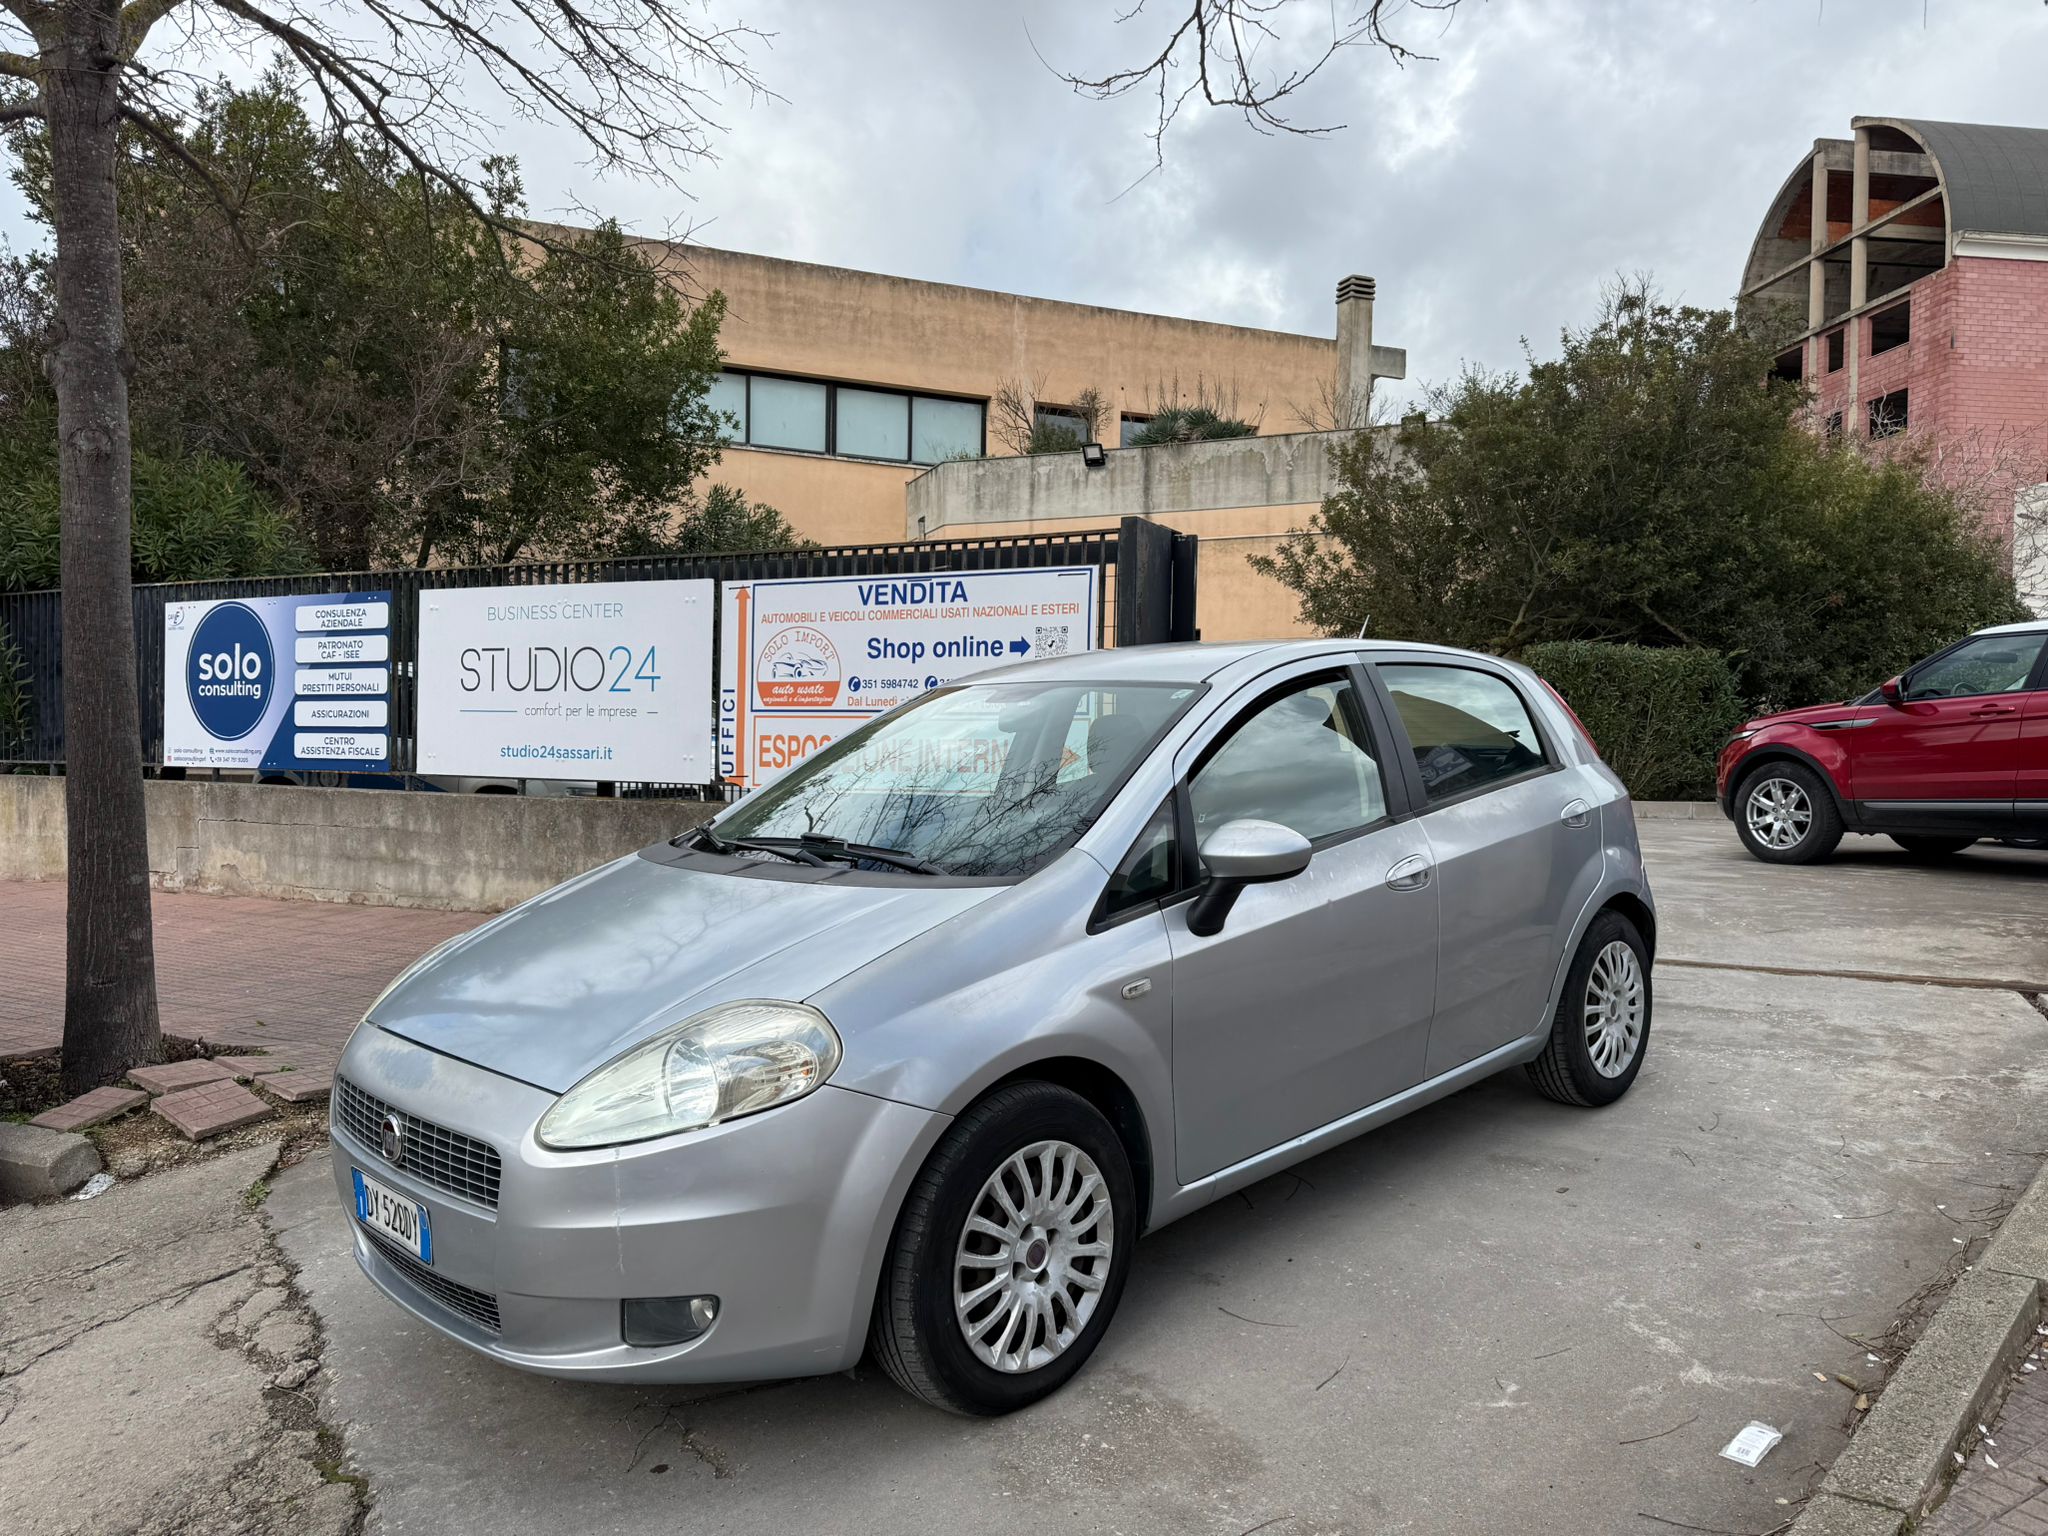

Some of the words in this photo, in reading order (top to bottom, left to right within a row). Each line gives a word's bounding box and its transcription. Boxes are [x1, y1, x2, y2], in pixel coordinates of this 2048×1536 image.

[857, 581, 968, 606] VENDITA
[315, 608, 367, 619] CONSULENZA
[487, 604, 558, 621] BUSINESS
[562, 602, 624, 619] CENTER
[761, 612, 817, 624] AUTOMOBILI
[819, 611, 826, 622] E
[828, 610, 865, 622] VEICOLI
[868, 607, 938, 621] COMMERCIALI
[941, 607, 969, 619] USATI
[973, 605, 1028, 617] NAZIONALI
[1031, 604, 1038, 616] E
[1041, 603, 1079, 615] ESTERI
[321, 618, 363, 628] AZIENDALE
[318, 640, 364, 650] PATRONATO
[764, 634, 789, 662] SOLO
[795, 630, 835, 660] IMPORT
[867, 637, 924, 664] Shop
[932, 636, 1004, 657] online
[199, 643, 262, 680] solo
[321, 650, 336, 659] CAF
[343, 650, 360, 658] ISEE
[328, 672, 352, 681] MUTUI
[460, 645, 662, 692] STUDIO24
[198, 681, 262, 699] consulting
[302, 683, 334, 692] PRESTITI
[336, 683, 379, 692] PERSONALI
[771, 684, 795, 694] auto
[797, 684, 825, 694] usate
[862, 679, 877, 689] 351
[881, 679, 919, 689] 5984742
[848, 696, 863, 706] Dal
[311, 710, 370, 718] ASSICURAZIONI
[524, 702, 563, 717] comfort
[566, 705, 582, 721] per
[587, 703, 595, 717] le
[598, 705, 638, 722] imprese
[721, 688, 735, 775] UFFICI
[324, 737, 355, 745] CENTRO
[300, 746, 346, 755] ASSISTENZA
[348, 747, 380, 756] FISCALE
[500, 744, 613, 760] studio24sassari.it
[918, 738, 1009, 774] INTERN
[365, 1185, 379, 1221] DY
[383, 1194, 417, 1246] 520DY
